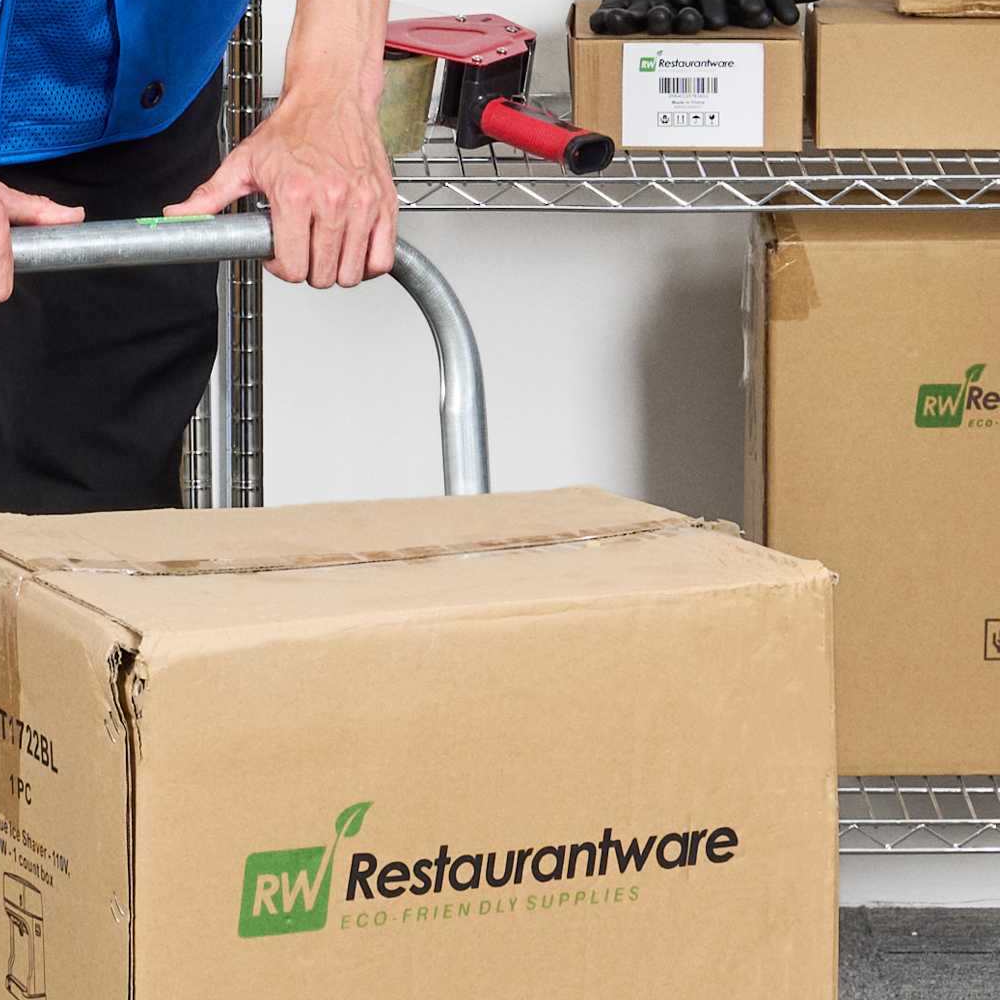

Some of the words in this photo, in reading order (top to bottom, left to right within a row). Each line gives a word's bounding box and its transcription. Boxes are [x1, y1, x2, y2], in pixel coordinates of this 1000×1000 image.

[659, 58, 735, 69] Restaurantware
[923, 395, 960, 416] RW
[9, 773, 15, 796] 1
[17, 777, 32, 806] PC
[9, 821, 21, 843] Ice
[22, 829, 48, 861] Shaver
[13, 847, 18, 863] 1
[18, 853, 40, 879] count
[40, 867, 54, 888] box
[346, 825, 739, 901] Restaurantware
[252, 873, 322, 917] RW
[527, 885, 640, 911] SUPPLIES
